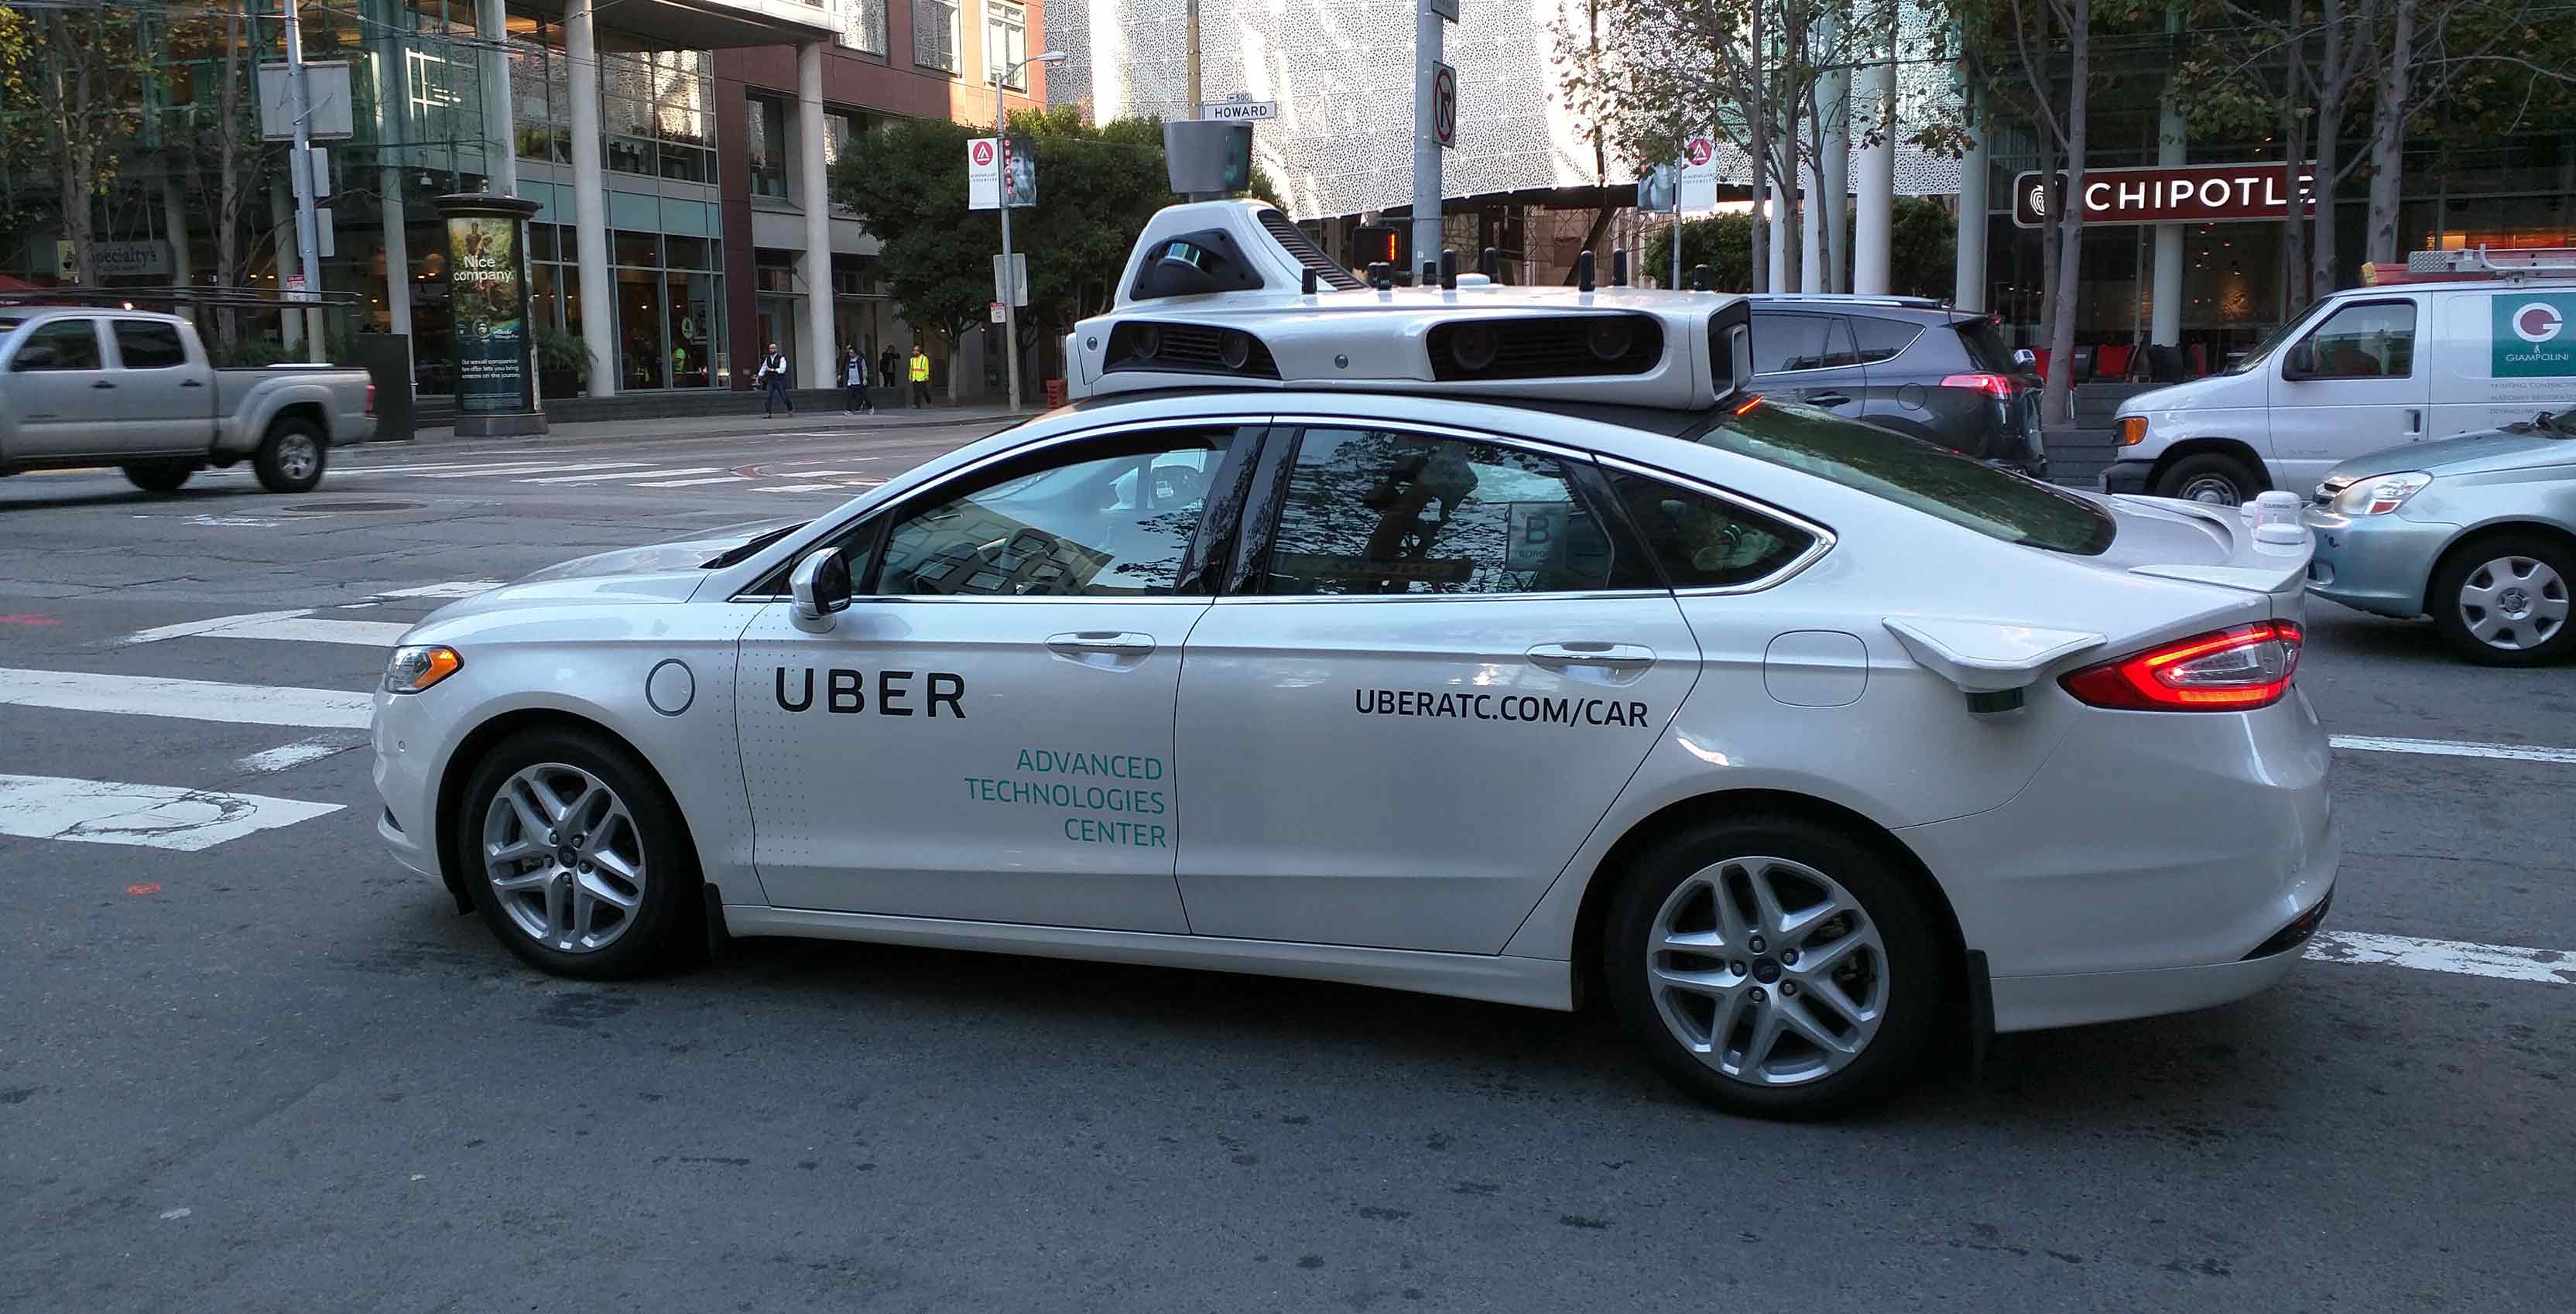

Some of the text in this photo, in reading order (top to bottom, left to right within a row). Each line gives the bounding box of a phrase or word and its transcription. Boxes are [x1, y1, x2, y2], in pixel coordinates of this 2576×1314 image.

[1214, 105, 1267, 118] HOWARD
[2085, 176, 2316, 210] CHIPOTLE
[87, 245, 157, 267] pecialty's
[464, 254, 495, 268] Nice
[454, 271, 514, 283] company.
[2513, 303, 2564, 343] G
[2506, 353, 2569, 362] GIAMPOLINI
[775, 666, 966, 719] UBER
[1355, 688, 1649, 728] UBERATC.COM/CAR
[1016, 748, 1162, 781] ADVANCED
[964, 777, 1164, 815] TECHNOLOGIES
[1064, 817, 1166, 848] CENTER
